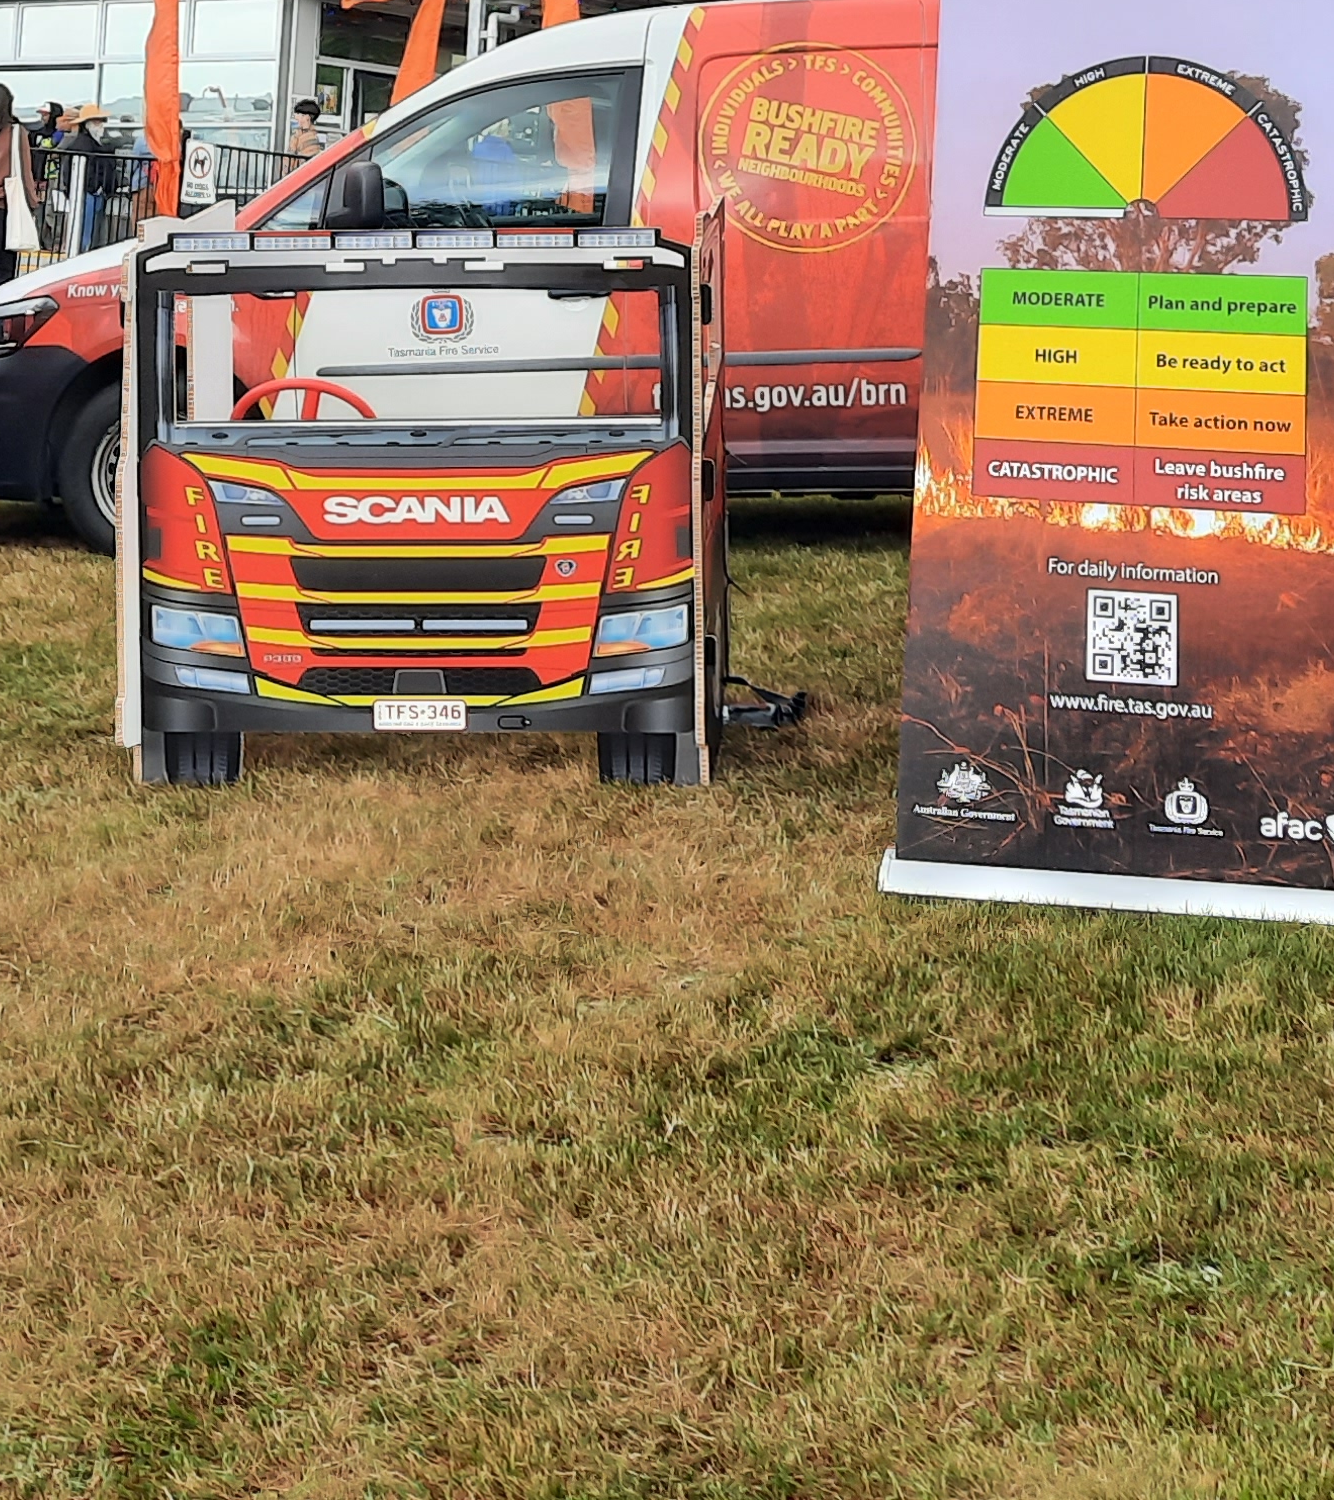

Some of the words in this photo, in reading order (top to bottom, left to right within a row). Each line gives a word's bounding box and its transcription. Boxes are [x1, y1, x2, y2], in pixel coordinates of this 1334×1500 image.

[1074, 67, 1106, 88] HIGH
[1176, 63, 1236, 97] EXTREME
[711, 59, 785, 156] INDIVIDUALS
[803, 54, 839, 73] TFS
[852, 71, 905, 188] COMMUNITIES
[748, 96, 880, 147] BUSHFIRE
[741, 121, 876, 180] READY
[992, 122, 1030, 191] MODERATE
[1257, 113, 1303, 212] CATASTROPHIC
[737, 157, 866, 198] NEIGHBOURHOODS
[717, 170, 744, 200] WE
[734, 199, 765, 228] ALL
[766, 218, 816, 240] PLAY
[819, 222, 833, 239] A
[834, 198, 880, 233] PART
[67, 283, 108, 299] Know
[1012, 291, 1105, 308] MODERATE
[1148, 295, 1185, 311] Plan
[1190, 296, 1222, 312] and
[1227, 301, 1298, 322] prepare
[388, 347, 436, 358] Tasmania
[439, 345, 458, 356] Fire
[461, 344, 499, 355] Service
[1035, 348, 1077, 364] HIGH
[1156, 354, 1178, 369] Be
[1182, 356, 1232, 374] ready
[1236, 358, 1255, 372] to
[1259, 359, 1287, 373] act
[1016, 404, 1094, 423] EXTREME
[1149, 412, 1189, 428] Take
[1193, 415, 1249, 432] action
[1253, 420, 1292, 433] now
[988, 460, 1119, 484] CATASTROPHIC
[1154, 458, 1207, 477] Leave
[1210, 461, 1286, 481] bushfire
[1176, 484, 1210, 501] risk
[1213, 489, 1263, 504] areas
[322, 495, 511, 524] SCANIA
[1048, 557, 1074, 575] For
[1078, 559, 1117, 581] daily
[1121, 562, 1219, 584] information
[1049, 693, 1213, 719] www.fire.tas.gov.au
[913, 804, 958, 818] Australian
[961, 807, 1016, 822] Government
[1054, 816, 1115, 829] Government
[1058, 804, 1110, 818] Tasmanian
[1260, 812, 1323, 841] afac
